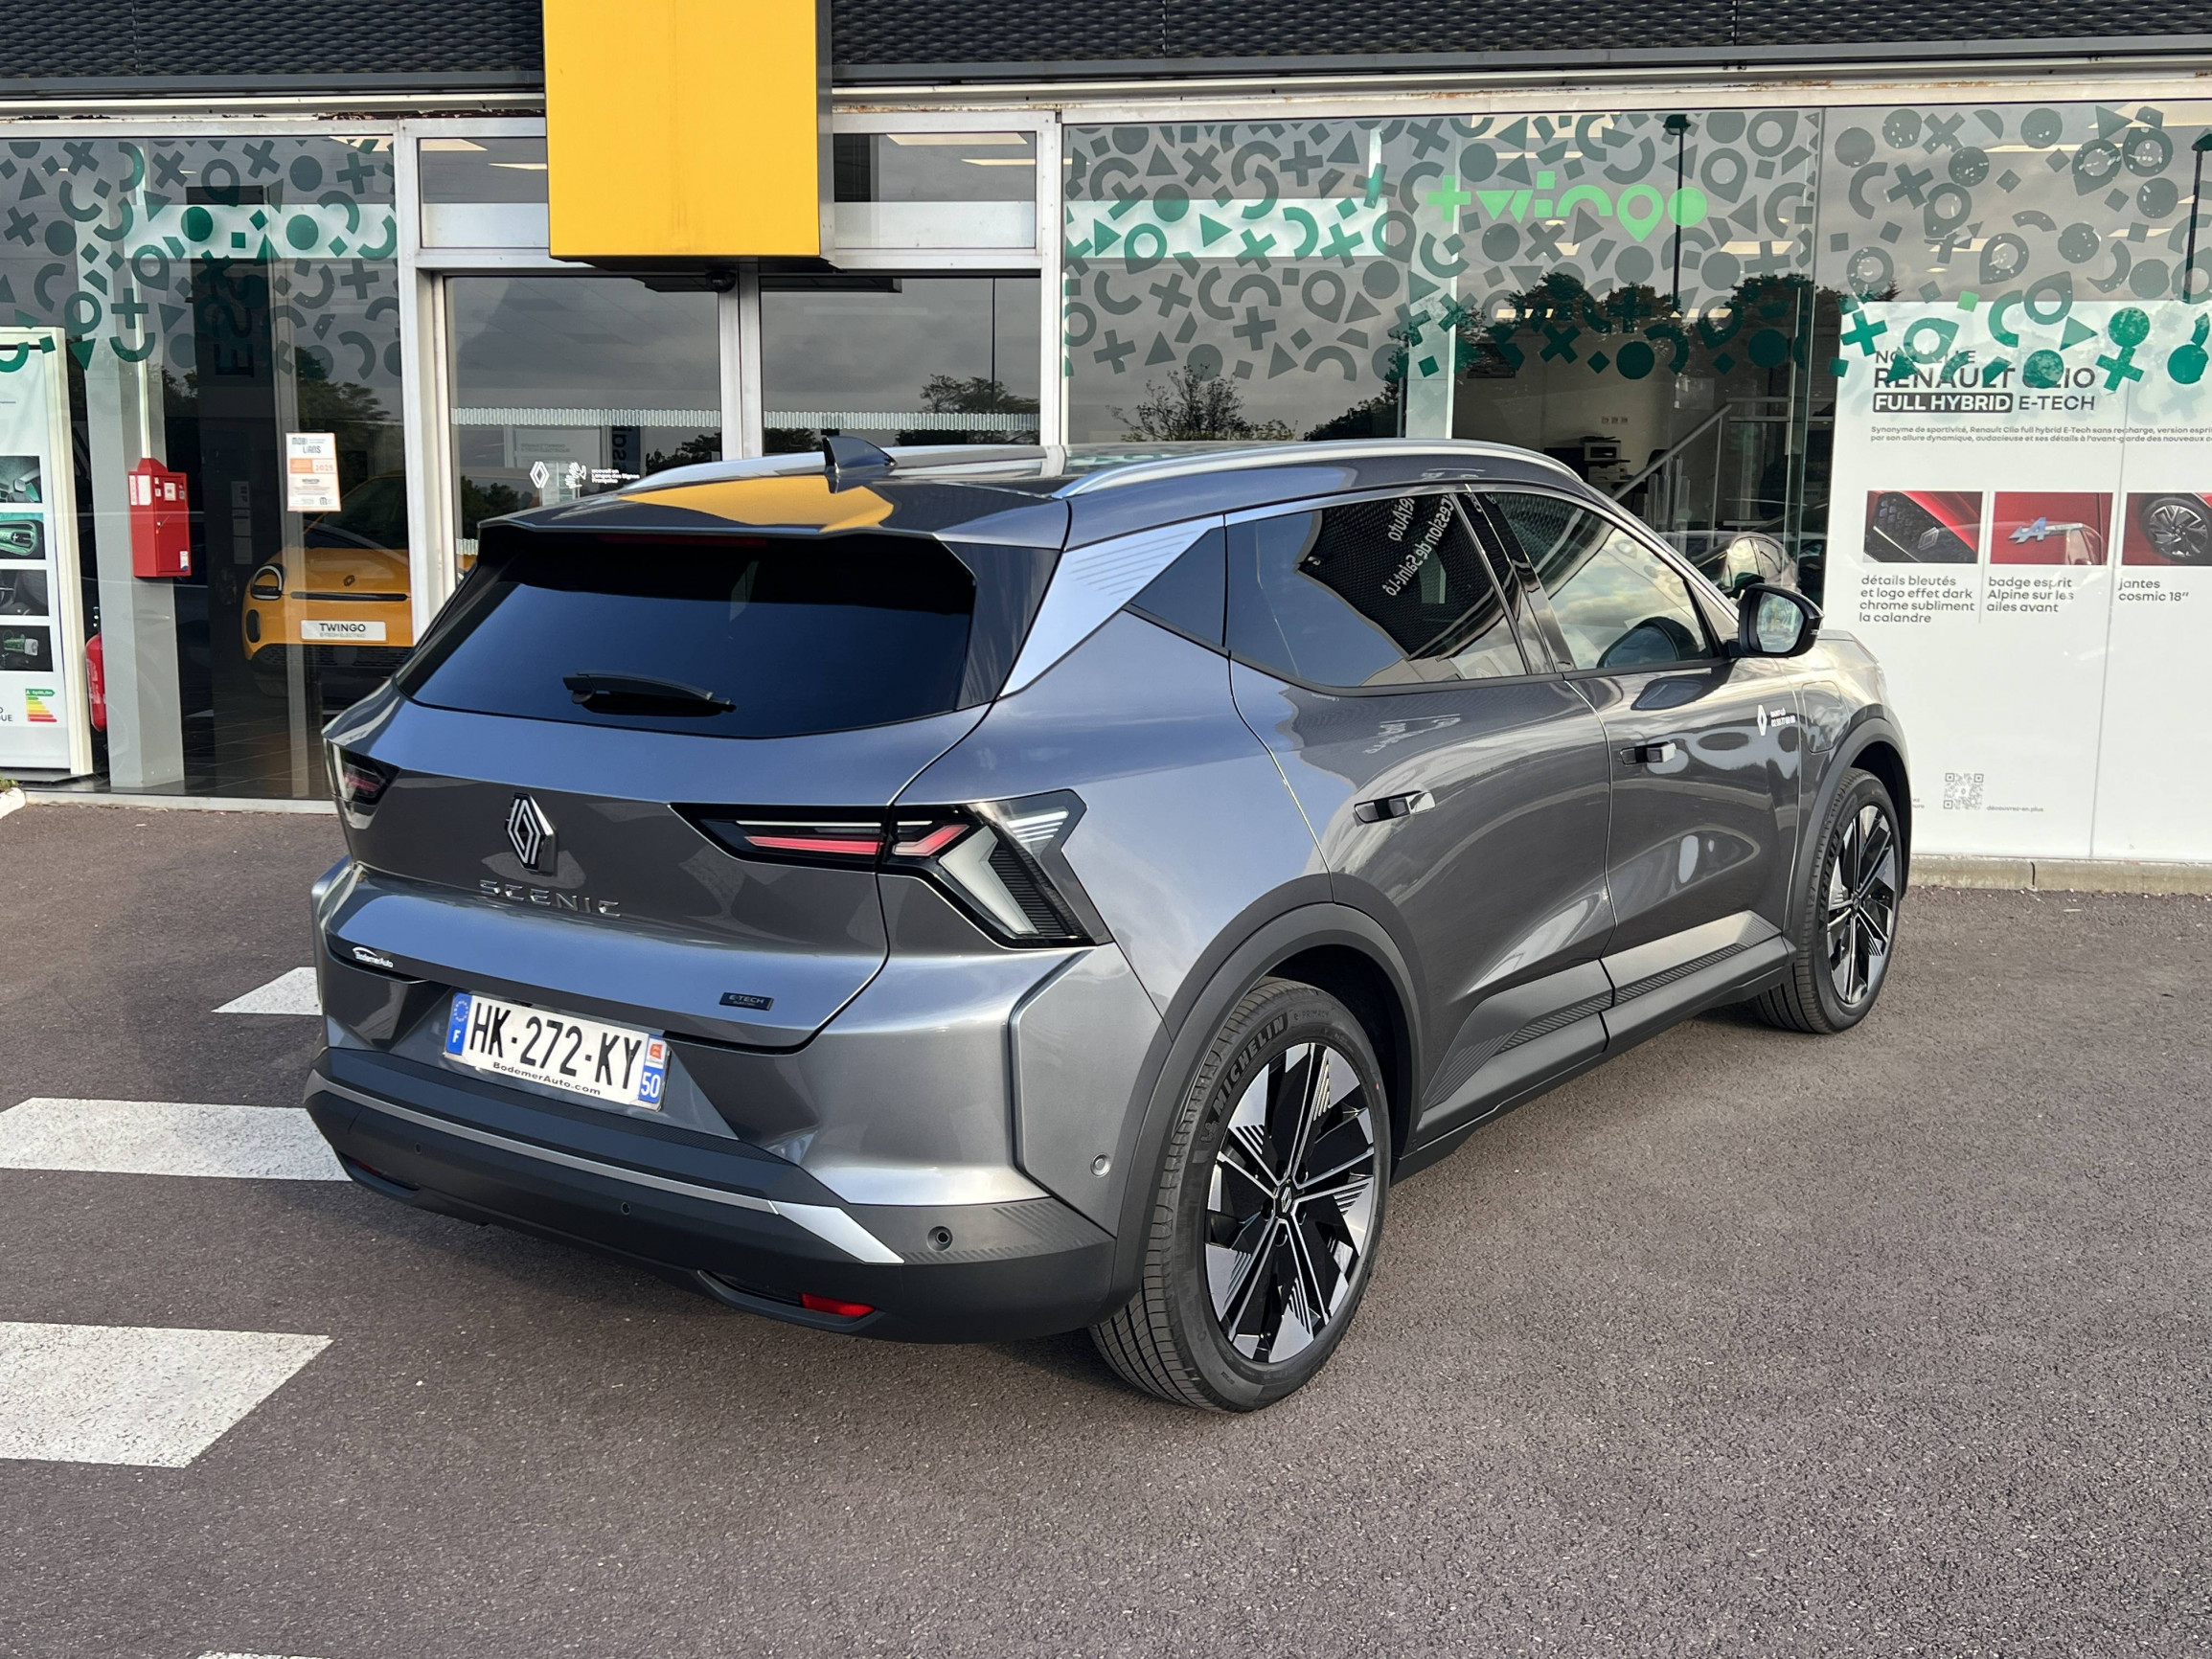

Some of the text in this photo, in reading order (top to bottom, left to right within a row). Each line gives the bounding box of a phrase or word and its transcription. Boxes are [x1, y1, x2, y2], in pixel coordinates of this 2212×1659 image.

[1875, 395, 2095, 412] FULL HYBRID E-TECH
[1871, 426, 1914, 435] Synonyme
[2036, 427, 2062, 436] hybrid
[1861, 575, 1956, 586] détails bleutés
[1988, 577, 2072, 590] badge esprit
[2118, 578, 2161, 591] jantes
[1860, 588, 1973, 601] et logo effet dark
[1987, 589, 2074, 602] Alpine sur les
[2118, 591, 2166, 602] cosmic
[1859, 600, 1975, 611] chrome subliment
[1987, 602, 2059, 613] ailes avant
[1859, 612, 1931, 624] la calandre
[319, 623, 366, 632] TWINGO
[479, 878, 621, 917] SCENIC
[451, 1029, 462, 1043] F
[1212, 1015, 1285, 1117] MICHELIN
[492, 1060, 601, 1096] BodemerAuto.com
[640, 1072, 661, 1099] 50
